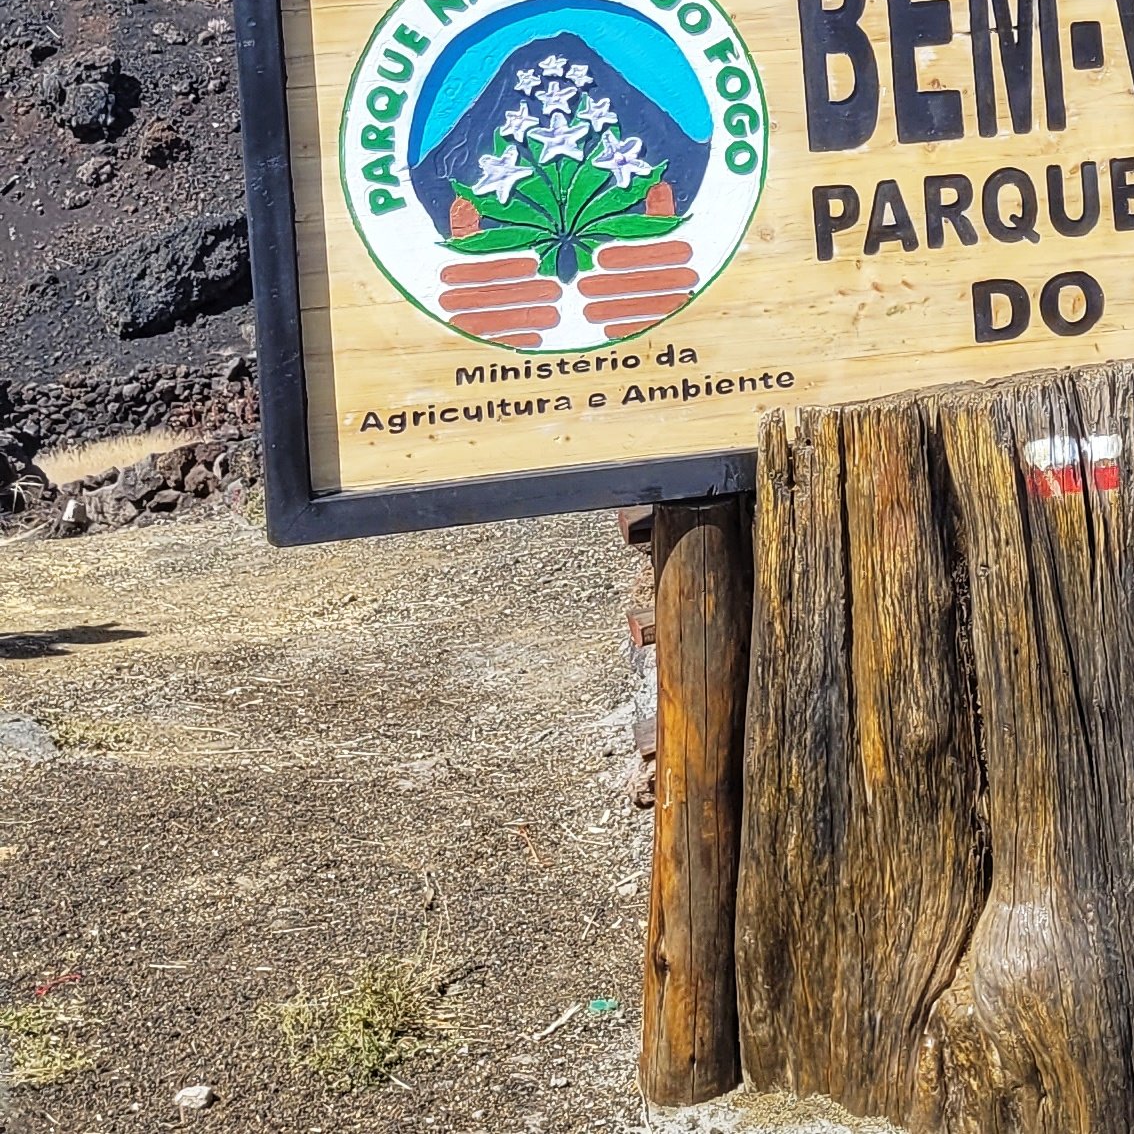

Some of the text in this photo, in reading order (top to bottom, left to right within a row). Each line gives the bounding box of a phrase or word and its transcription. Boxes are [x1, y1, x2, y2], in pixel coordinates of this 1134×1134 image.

[361, 24, 431, 216] PARQUE
[703, 36, 760, 176] FOGO
[972, 270, 1105, 343] DO
[655, 343, 698, 367] da
[359, 370, 796, 435] Agricultura e Ambiente
